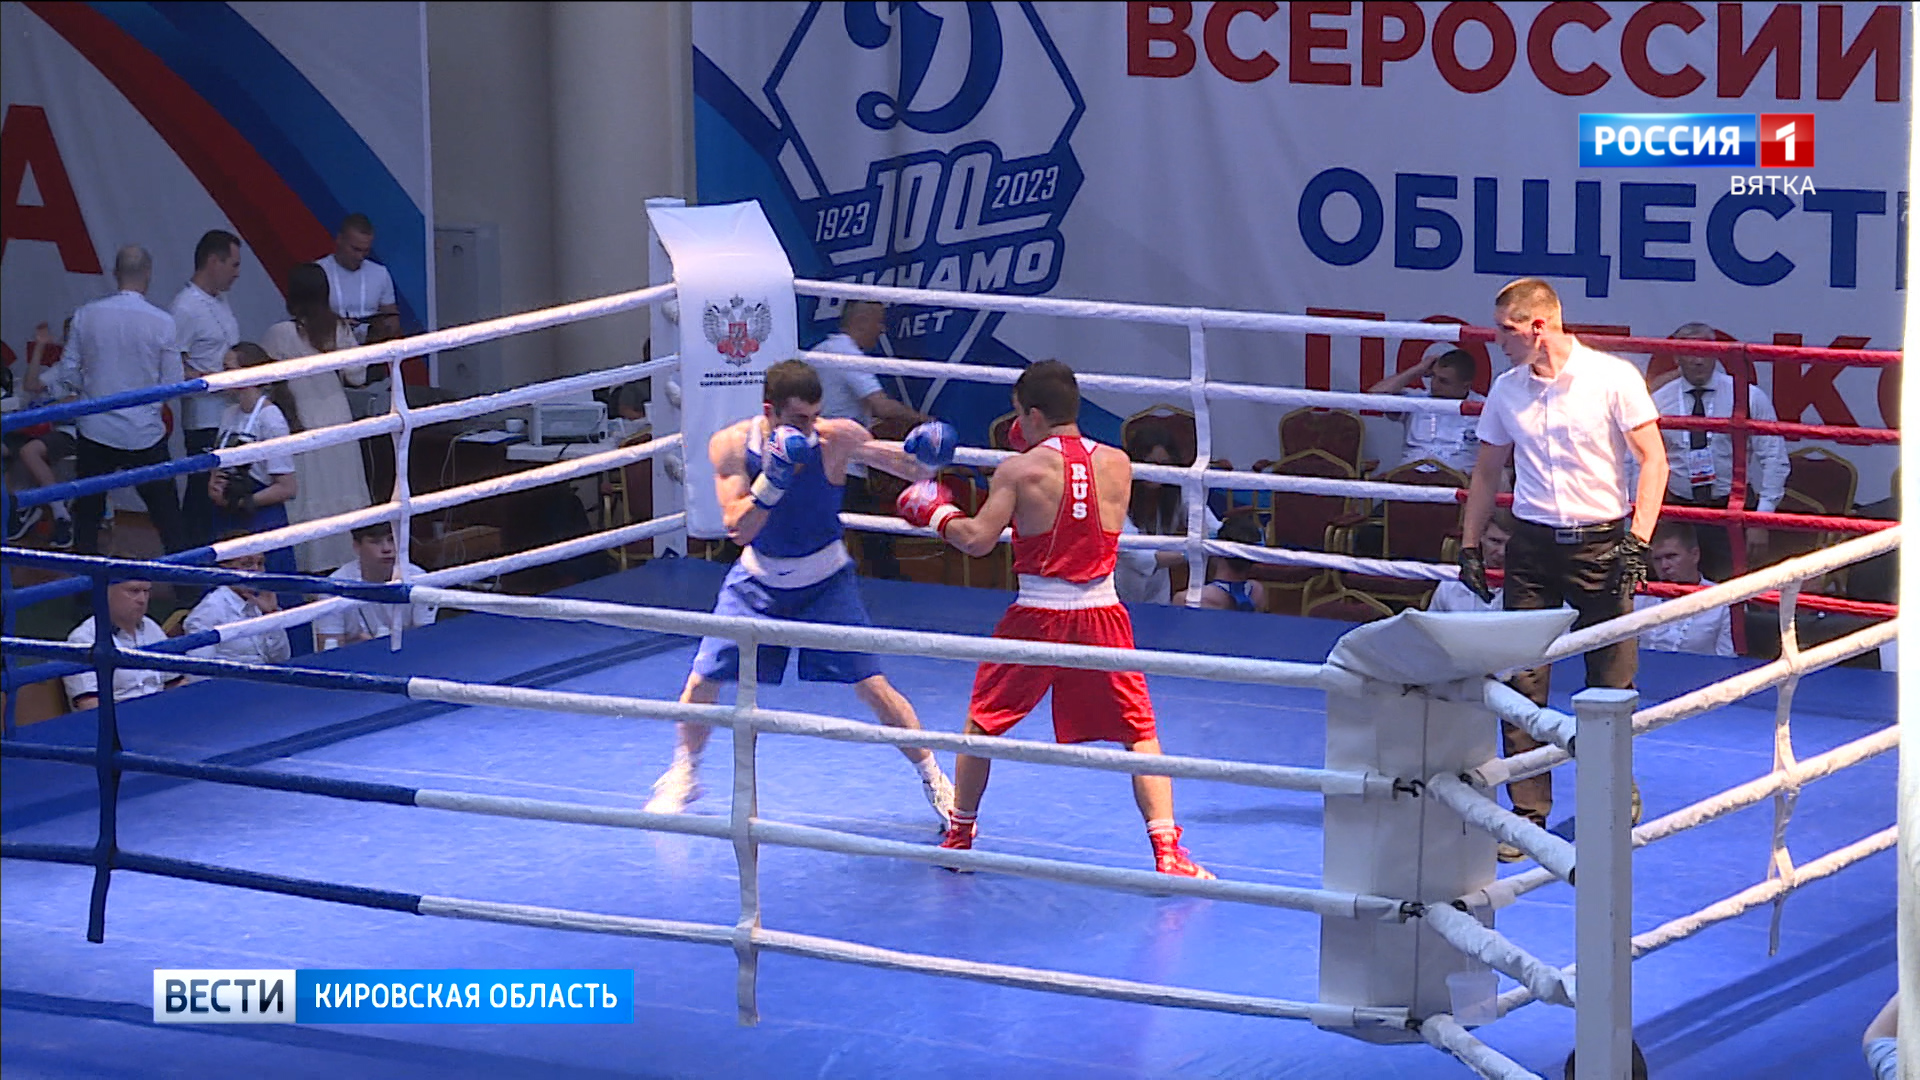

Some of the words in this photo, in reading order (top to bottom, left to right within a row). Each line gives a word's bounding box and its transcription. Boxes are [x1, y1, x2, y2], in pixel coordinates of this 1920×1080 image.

[862, 151, 997, 258] 100
[992, 165, 1059, 209] 2023
[815, 202, 870, 243] 1923
[899, 309, 954, 338] ЛЕТ
[1070, 463, 1089, 520] RUS
